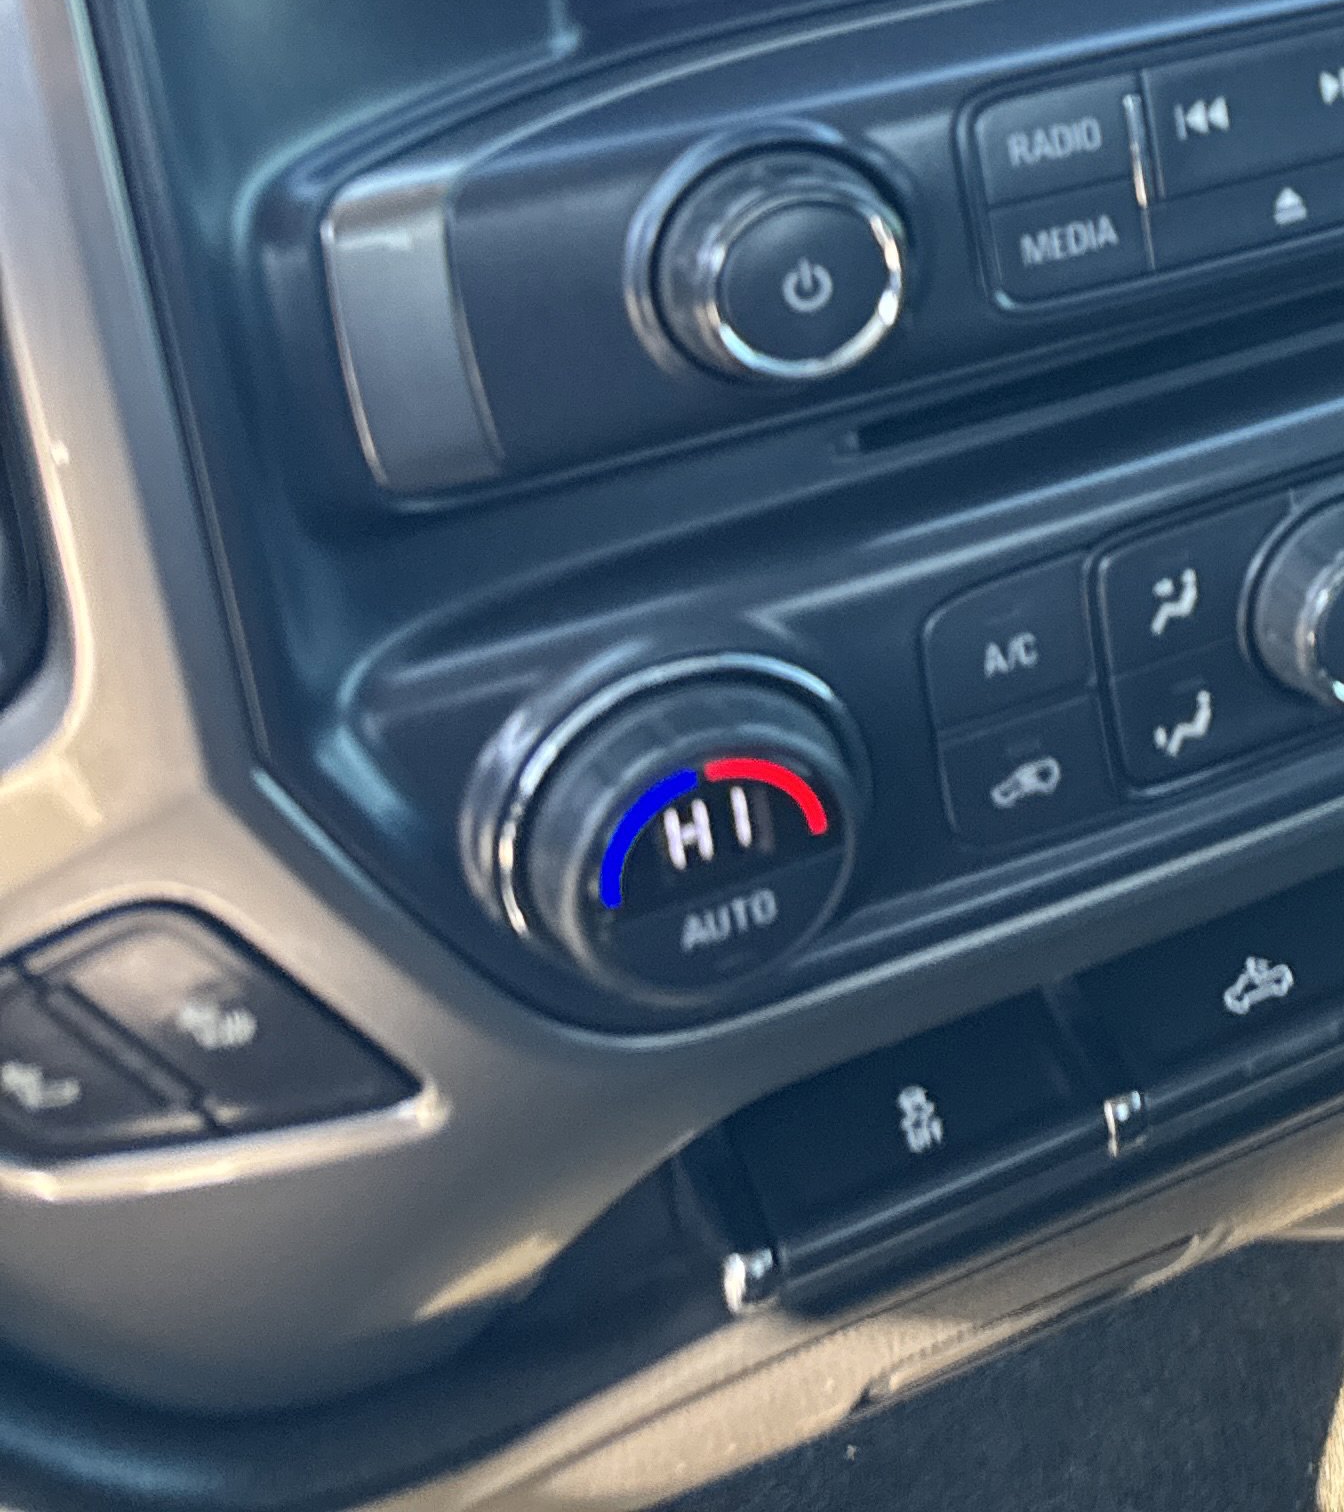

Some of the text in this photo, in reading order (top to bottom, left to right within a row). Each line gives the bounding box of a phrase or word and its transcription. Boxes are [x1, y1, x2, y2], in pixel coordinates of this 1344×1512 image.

[1006, 118, 1102, 167] RADIO
[1019, 216, 1119, 267] MEDIA
[984, 631, 1037, 678] A/C
[681, 890, 777, 951] AUTO
